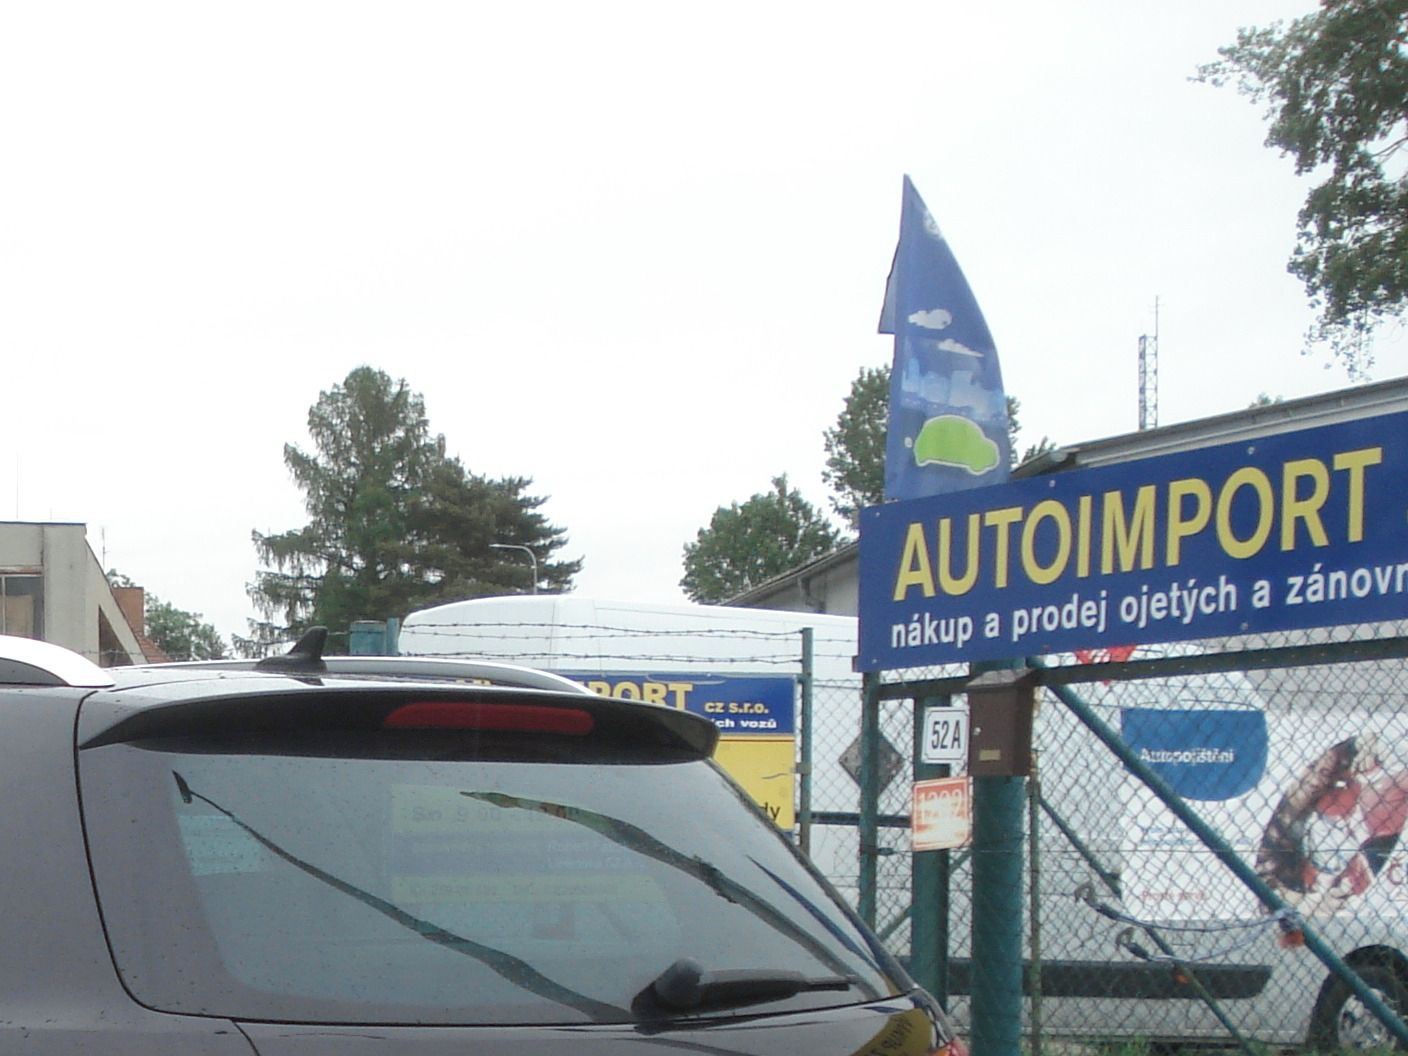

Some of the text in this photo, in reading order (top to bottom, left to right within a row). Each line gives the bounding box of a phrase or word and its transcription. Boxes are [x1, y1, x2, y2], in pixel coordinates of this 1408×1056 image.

[893, 446, 1383, 602] AUTOIMPORT
[891, 611, 974, 650] nákup
[984, 613, 1001, 638] a
[1012, 594, 1108, 642] prodej
[1120, 578, 1238, 632] ojetých
[1252, 577, 1271, 608] a
[704, 701, 725, 713] cz
[728, 702, 770, 714] s.r.o.
